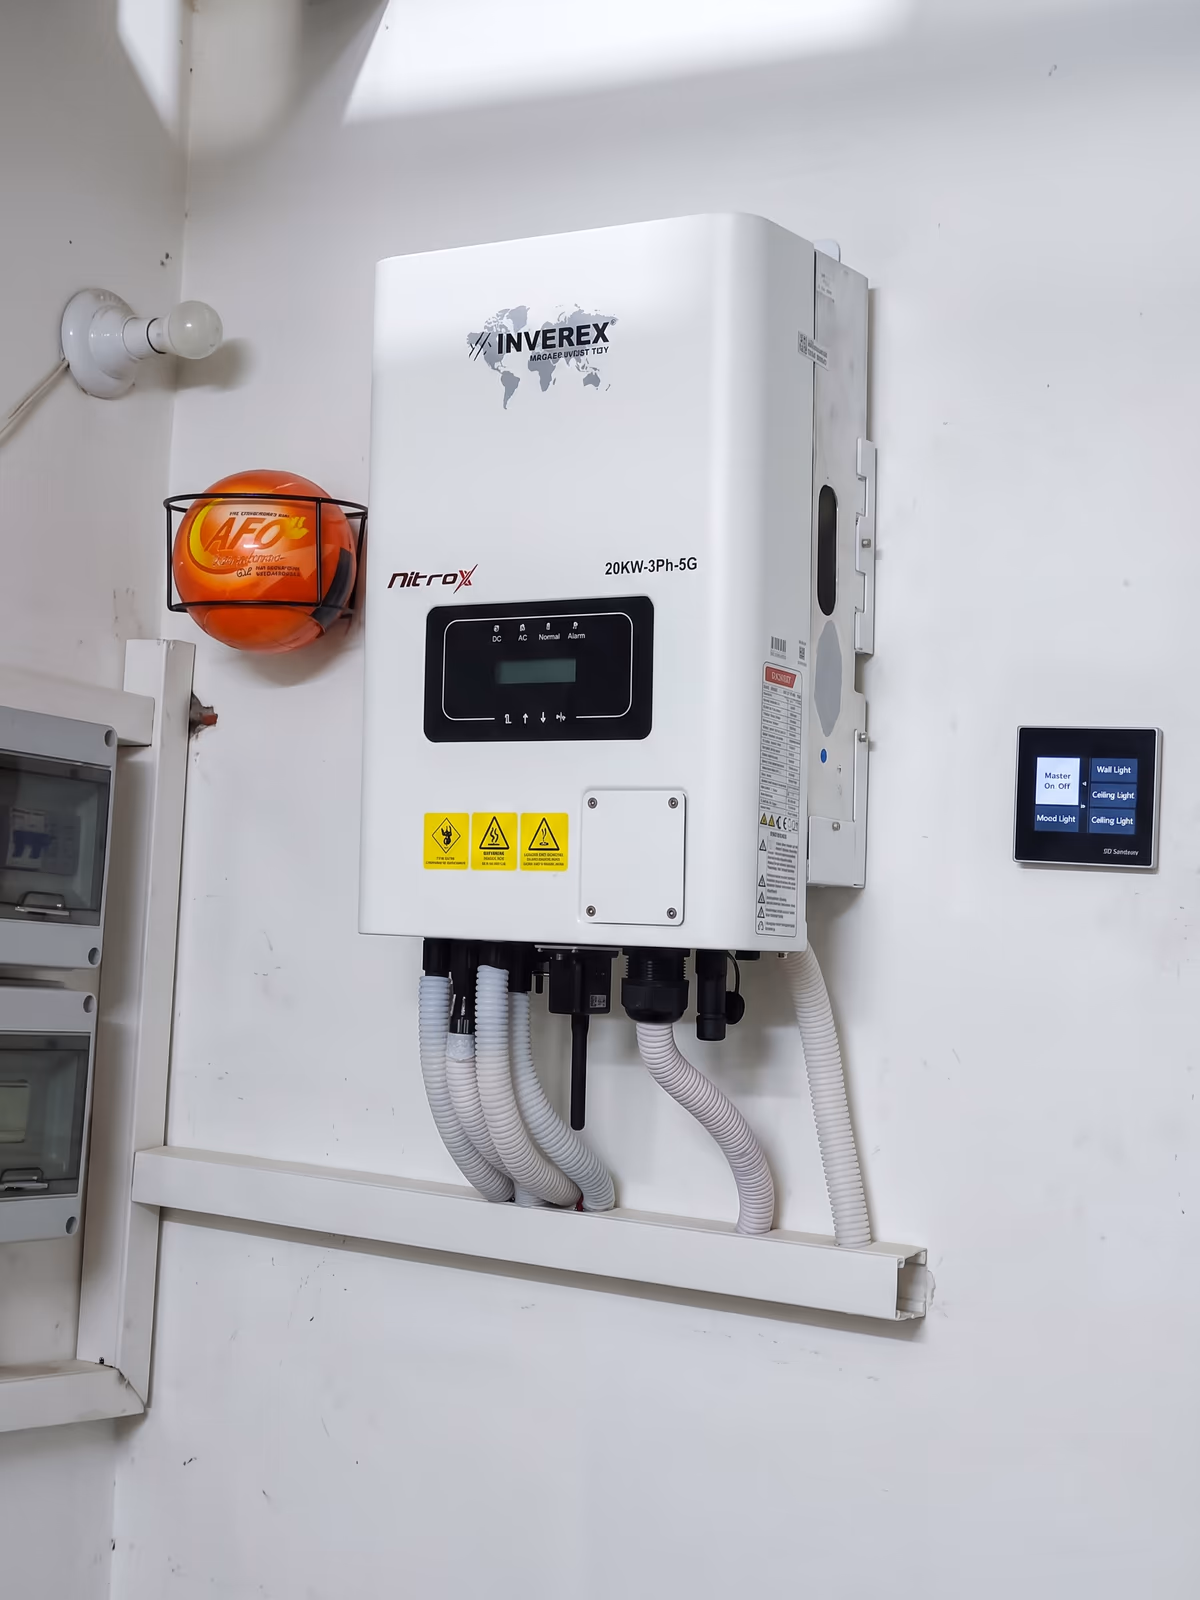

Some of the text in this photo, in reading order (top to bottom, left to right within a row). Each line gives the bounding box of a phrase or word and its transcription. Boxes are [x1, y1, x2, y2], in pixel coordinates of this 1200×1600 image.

[498, 321, 610, 354] INVEREX
[204, 517, 286, 551] AFO
[605, 556, 698, 576] 20KW-3Ph-5G
[492, 635, 502, 643] DC
[538, 633, 560, 641] Normal
[567, 632, 586, 640] Alarm
[1097, 766, 1131, 775] Wall Light
[1044, 782, 1071, 790] On Off
[1092, 790, 1135, 801] Ceiling Light
[1036, 814, 1076, 825] Mood Light
[1091, 816, 1134, 826] Ceiling Light
